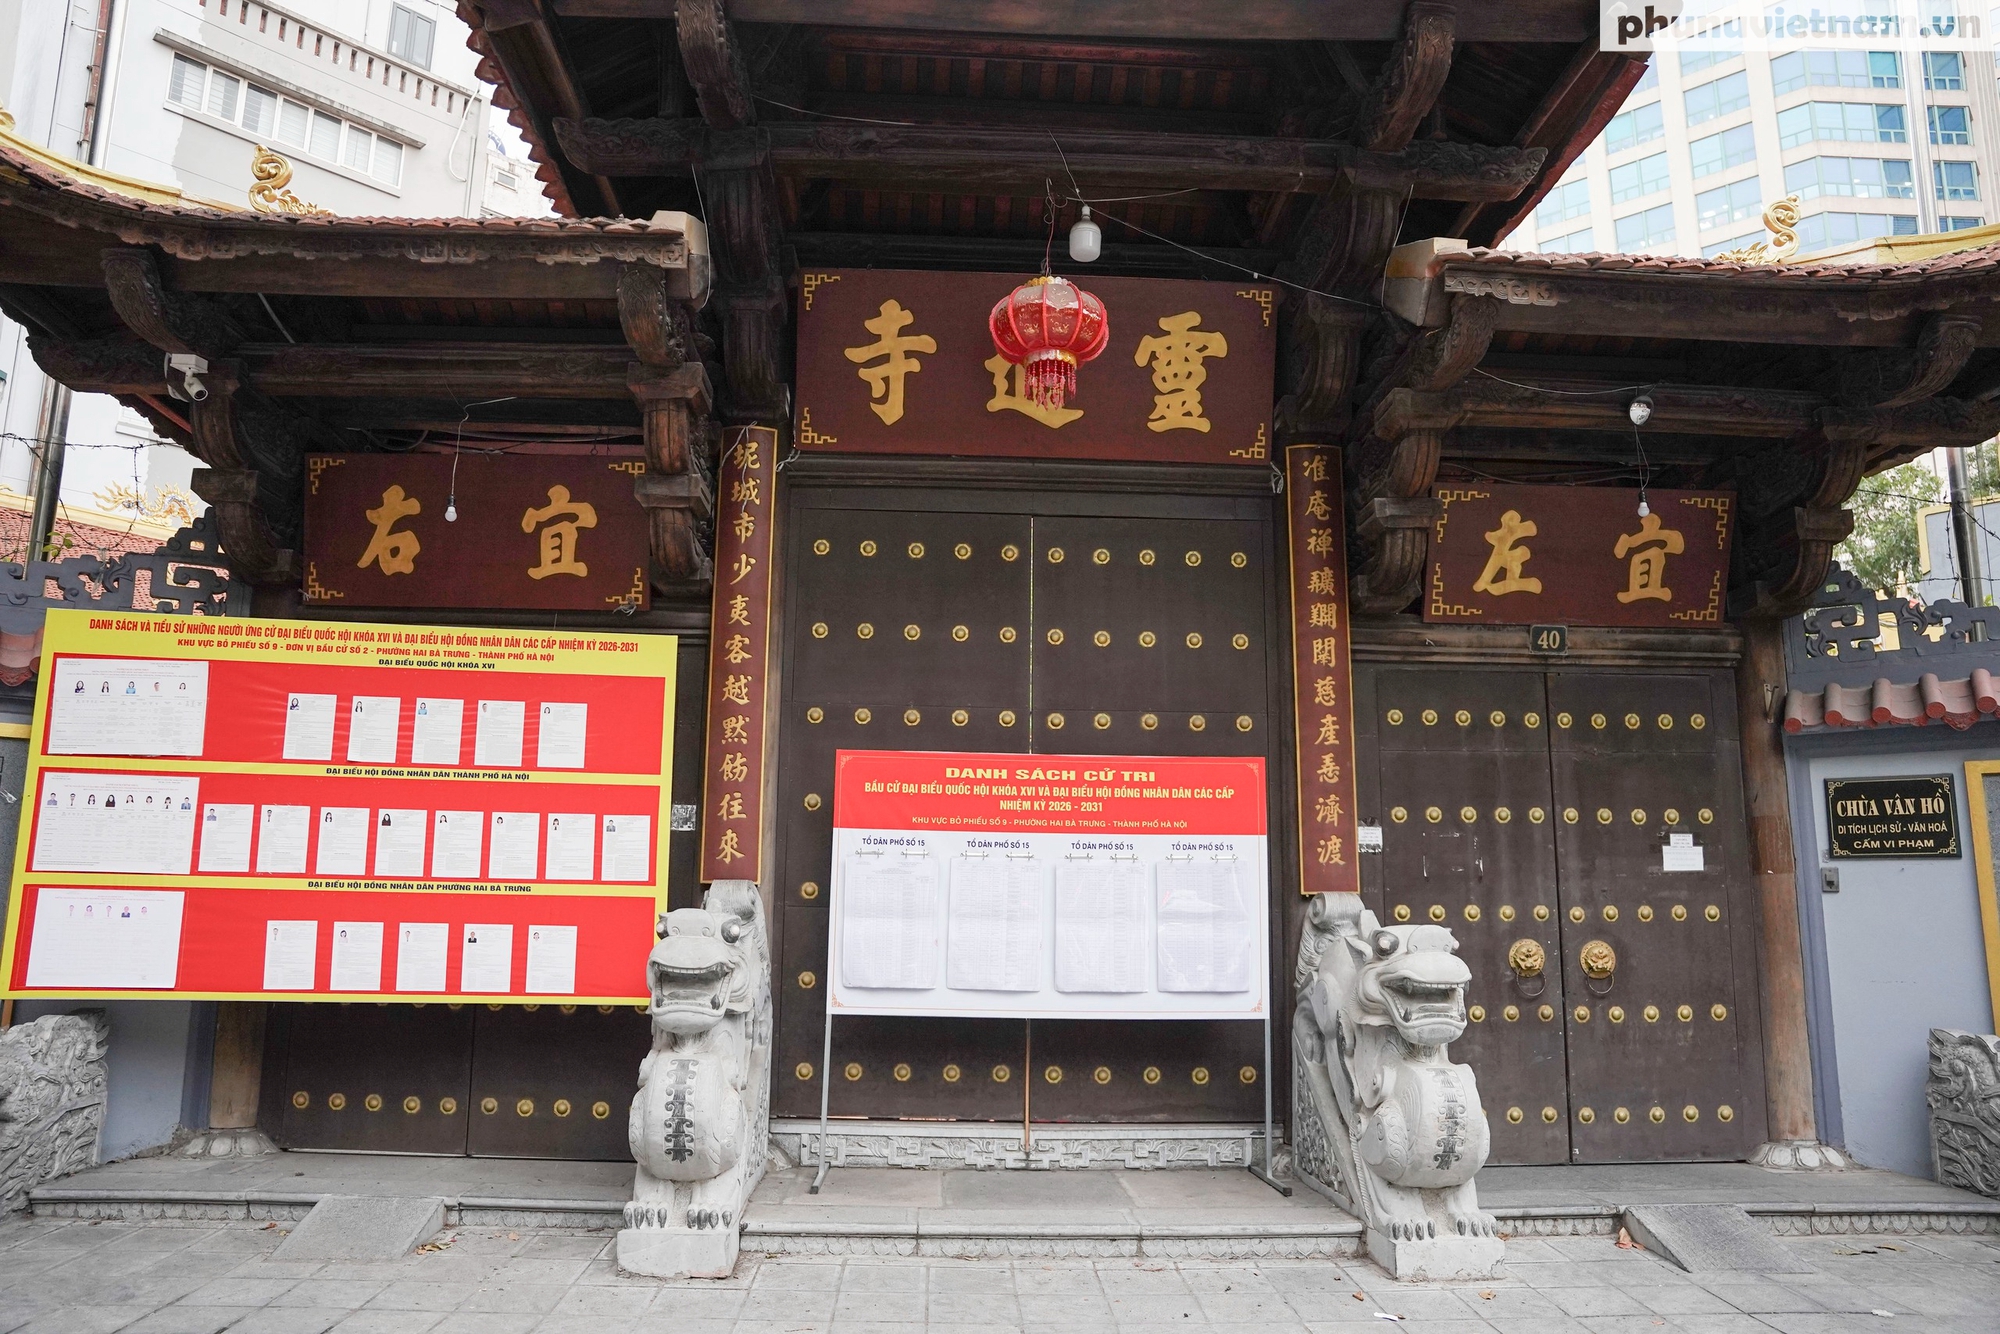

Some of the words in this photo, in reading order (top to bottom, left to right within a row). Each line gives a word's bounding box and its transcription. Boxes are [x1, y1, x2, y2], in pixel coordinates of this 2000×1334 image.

[90, 619, 113, 630] DANH
[115, 618, 138, 631] SÁCH
[140, 620, 151, 632] VÀ
[153, 619, 171, 633] TIỂU
[174, 620, 186, 633] SỬ
[187, 622, 215, 635] NHỮNG
[218, 623, 243, 636] NGƯỜI
[245, 625, 262, 637] ỨNG
[264, 625, 277, 638] CỬ
[278, 628, 291, 640] ĐẠI
[293, 625, 312, 639] BIỂU
[314, 627, 336, 641] QUỐC
[338, 629, 351, 643] HỘI
[353, 630, 375, 642] KHÓA
[377, 633, 390, 643] XVI
[392, 631, 403, 643] VÀ
[405, 633, 418, 646] ĐẠI
[420, 631, 439, 645] BIỂU
[441, 634, 454, 647] HỘI
[480, 635, 502, 647] NHÂN
[504, 636, 521, 648] DÂN
[523, 637, 539, 649] CÁC
[541, 636, 557, 649] CẤP
[559, 638, 584, 652] NHIỆM
[586, 639, 597, 651] KỲ
[598, 641, 639, 652] 2026-2031
[1537, 630, 1561, 650] 40
[198, 639, 214, 648] VỰC
[217, 638, 229, 648] BỎ
[231, 640, 256, 649] PHIẾU
[259, 641, 270, 649] SỐ
[286, 643, 303, 651] ĐƠN
[306, 645, 314, 653] VỊ
[336, 644, 348, 653] CỬ
[350, 645, 361, 653] SỐ
[376, 647, 411, 656] PHƯỜNG
[429, 648, 440, 657] BÀ
[443, 650, 470, 658] TRƯNG
[478, 650, 506, 660] THÀNH
[508, 651, 524, 660] PHỐ
[526, 652, 538, 661] HÀ
[540, 653, 555, 662] NỘI
[378, 658, 393, 666] ĐẠI
[395, 657, 414, 667] BIỂU
[416, 658, 439, 668] QUỐC
[441, 660, 455, 669] HỘI
[457, 661, 479, 669] KHÓA
[343, 766, 362, 775] BIỂU
[364, 768, 379, 777] HỘI
[433, 770, 450, 778] DÂN
[453, 771, 480, 779] THÀNH
[482, 771, 499, 779] PHỐ
[501, 772, 513, 780] HÀ
[515, 773, 530, 781] NỘI
[946, 768, 1008, 779] DANH
[1015, 768, 1076, 780] SÁCH
[1083, 768, 1116, 781] CỬ
[1121, 771, 1155, 782] TRI
[887, 780, 901, 793] CỬ
[902, 784, 918, 796] ĐẠI
[921, 780, 943, 794] BIỂU
[945, 782, 971, 795] QUỐC
[974, 783, 989, 797] HỘI
[992, 784, 1018, 796] KHÓA
[1020, 786, 1035, 796] XVI
[1038, 784, 1050, 796] VÀ
[1053, 787, 1069, 799] ĐẠI
[1072, 784, 1093, 797] BIỂU
[1096, 786, 1112, 799] HỘI
[1143, 787, 1169, 798] NHÂN
[1172, 787, 1191, 798] DÂN
[1194, 787, 1213, 798] CÁC
[1215, 786, 1234, 799] CẤP
[1000, 798, 1031, 813] NHIỆM
[1033, 799, 1046, 811] KỲ
[1049, 801, 1072, 811] 2026
[1080, 802, 1103, 812] 2031
[1836, 795, 1880, 817] CHÙA
[1883, 793, 1916, 816] VÂN
[1920, 788, 1945, 814] HỒ
[912, 816, 929, 824] KHU
[931, 817, 948, 825] VỰC
[950, 816, 962, 825] BỎ
[963, 816, 987, 825] PHIẾU
[989, 816, 1001, 825] SỐ
[1014, 818, 1048, 826] PHƯỜNG
[1065, 819, 1077, 827] BÀ
[1079, 820, 1106, 828] TRƯNG
[1113, 820, 1140, 828] THÀNH
[1142, 819, 1159, 828] PHỐ
[1160, 820, 1172, 828] HÀ
[1174, 820, 1188, 829] NỘI
[1838, 825, 1846, 834] DI
[1848, 823, 1867, 834] TÍCH
[1869, 823, 1888, 836] LỊCH
[1889, 821, 1902, 833] SỬ
[1908, 821, 1926, 833] VĂN
[1928, 821, 1948, 832] HOÁ
[873, 837, 888, 846] DÂN
[890, 836, 905, 846] PHỐ
[906, 837, 917, 846] SỐ
[978, 840, 992, 848] DÂN
[994, 839, 1009, 848] PHỐ
[1010, 839, 1021, 848] SỐ
[1082, 842, 1097, 850] DÂN
[1098, 841, 1114, 850] PHỐ
[1115, 841, 1125, 850] SỐ
[1182, 843, 1197, 851] DÂN
[1199, 841, 1213, 851] PHỐ
[1214, 841, 1225, 851] SỐ
[1853, 838, 1880, 849] CẤM
[1883, 840, 1895, 848] VI
[1899, 839, 1934, 850] PHẠM
[308, 881, 323, 889] ĐẠI
[325, 880, 345, 888] BIỂU
[347, 881, 361, 890] HỘI
[390, 882, 414, 890] NHÂN
[436, 883, 471, 891] PHƯỜNG
[490, 884, 501, 892] BÀ
